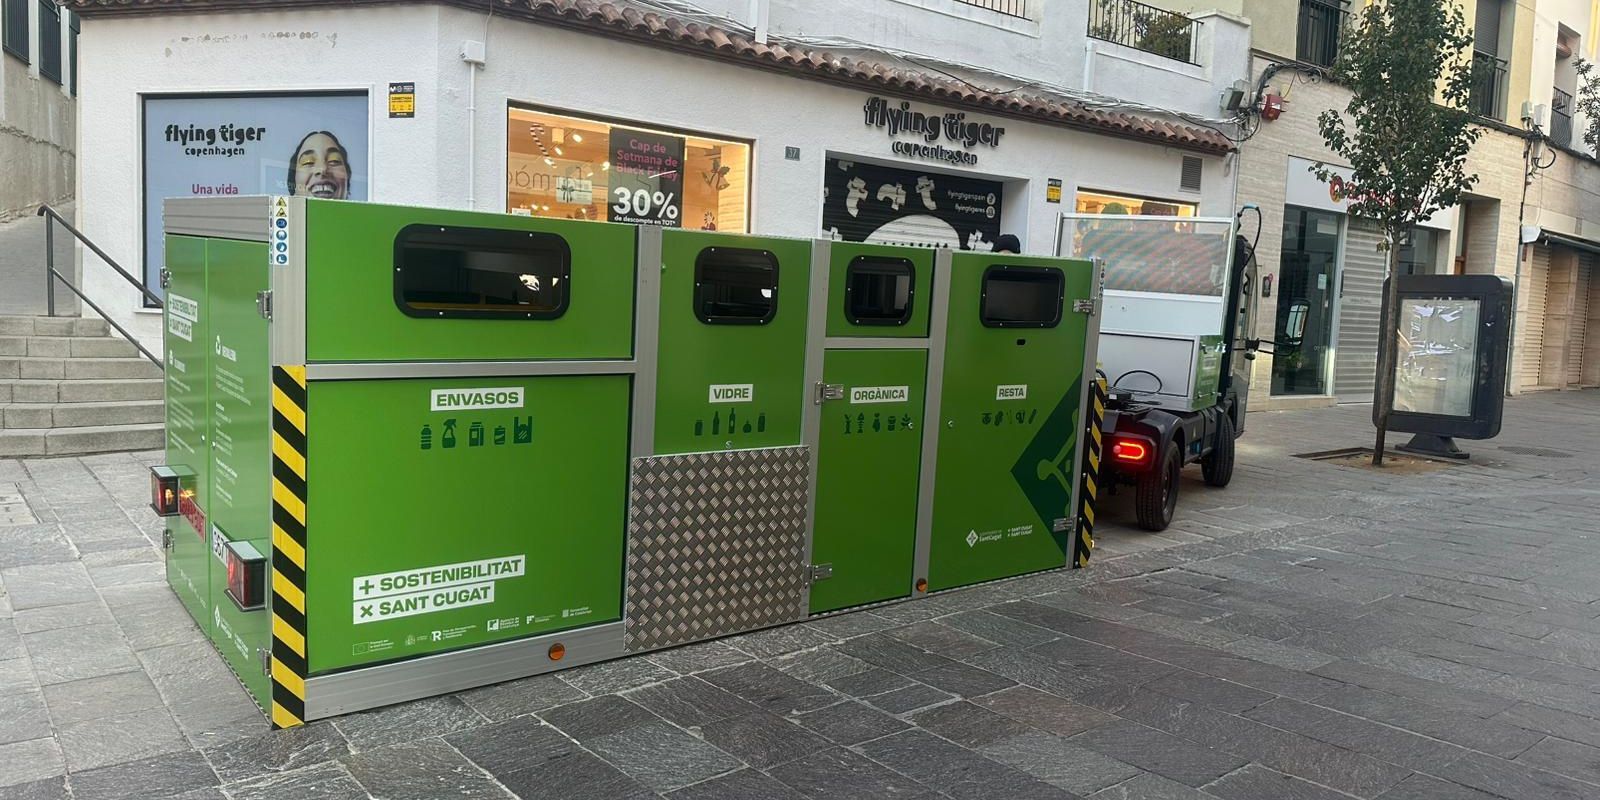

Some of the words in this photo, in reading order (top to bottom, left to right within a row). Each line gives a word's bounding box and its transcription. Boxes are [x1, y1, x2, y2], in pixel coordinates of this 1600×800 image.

[864, 97, 941, 142] flying
[943, 112, 1005, 147] tiger
[165, 124, 216, 146] flying
[219, 123, 266, 146] tiger
[185, 146, 245, 157] copenhagen
[630, 140, 650, 153] Cap
[653, 143, 666, 153] de
[892, 141, 978, 165] copenhagen
[617, 150, 662, 165] Setmana
[665, 157, 678, 167] de
[617, 163, 644, 176] Black
[192, 184, 213, 194] Una
[216, 184, 239, 195] vida
[613, 187, 678, 219] 30%
[437, 392, 519, 407] ENVASOS
[713, 388, 749, 399] VIDRE
[854, 387, 905, 401] ORGÀNICA
[999, 388, 1024, 397] RESTA
[380, 559, 521, 592] SOSTENIBILITAT
[379, 596, 429, 616] SANT
[432, 586, 491, 607] CUGAT
